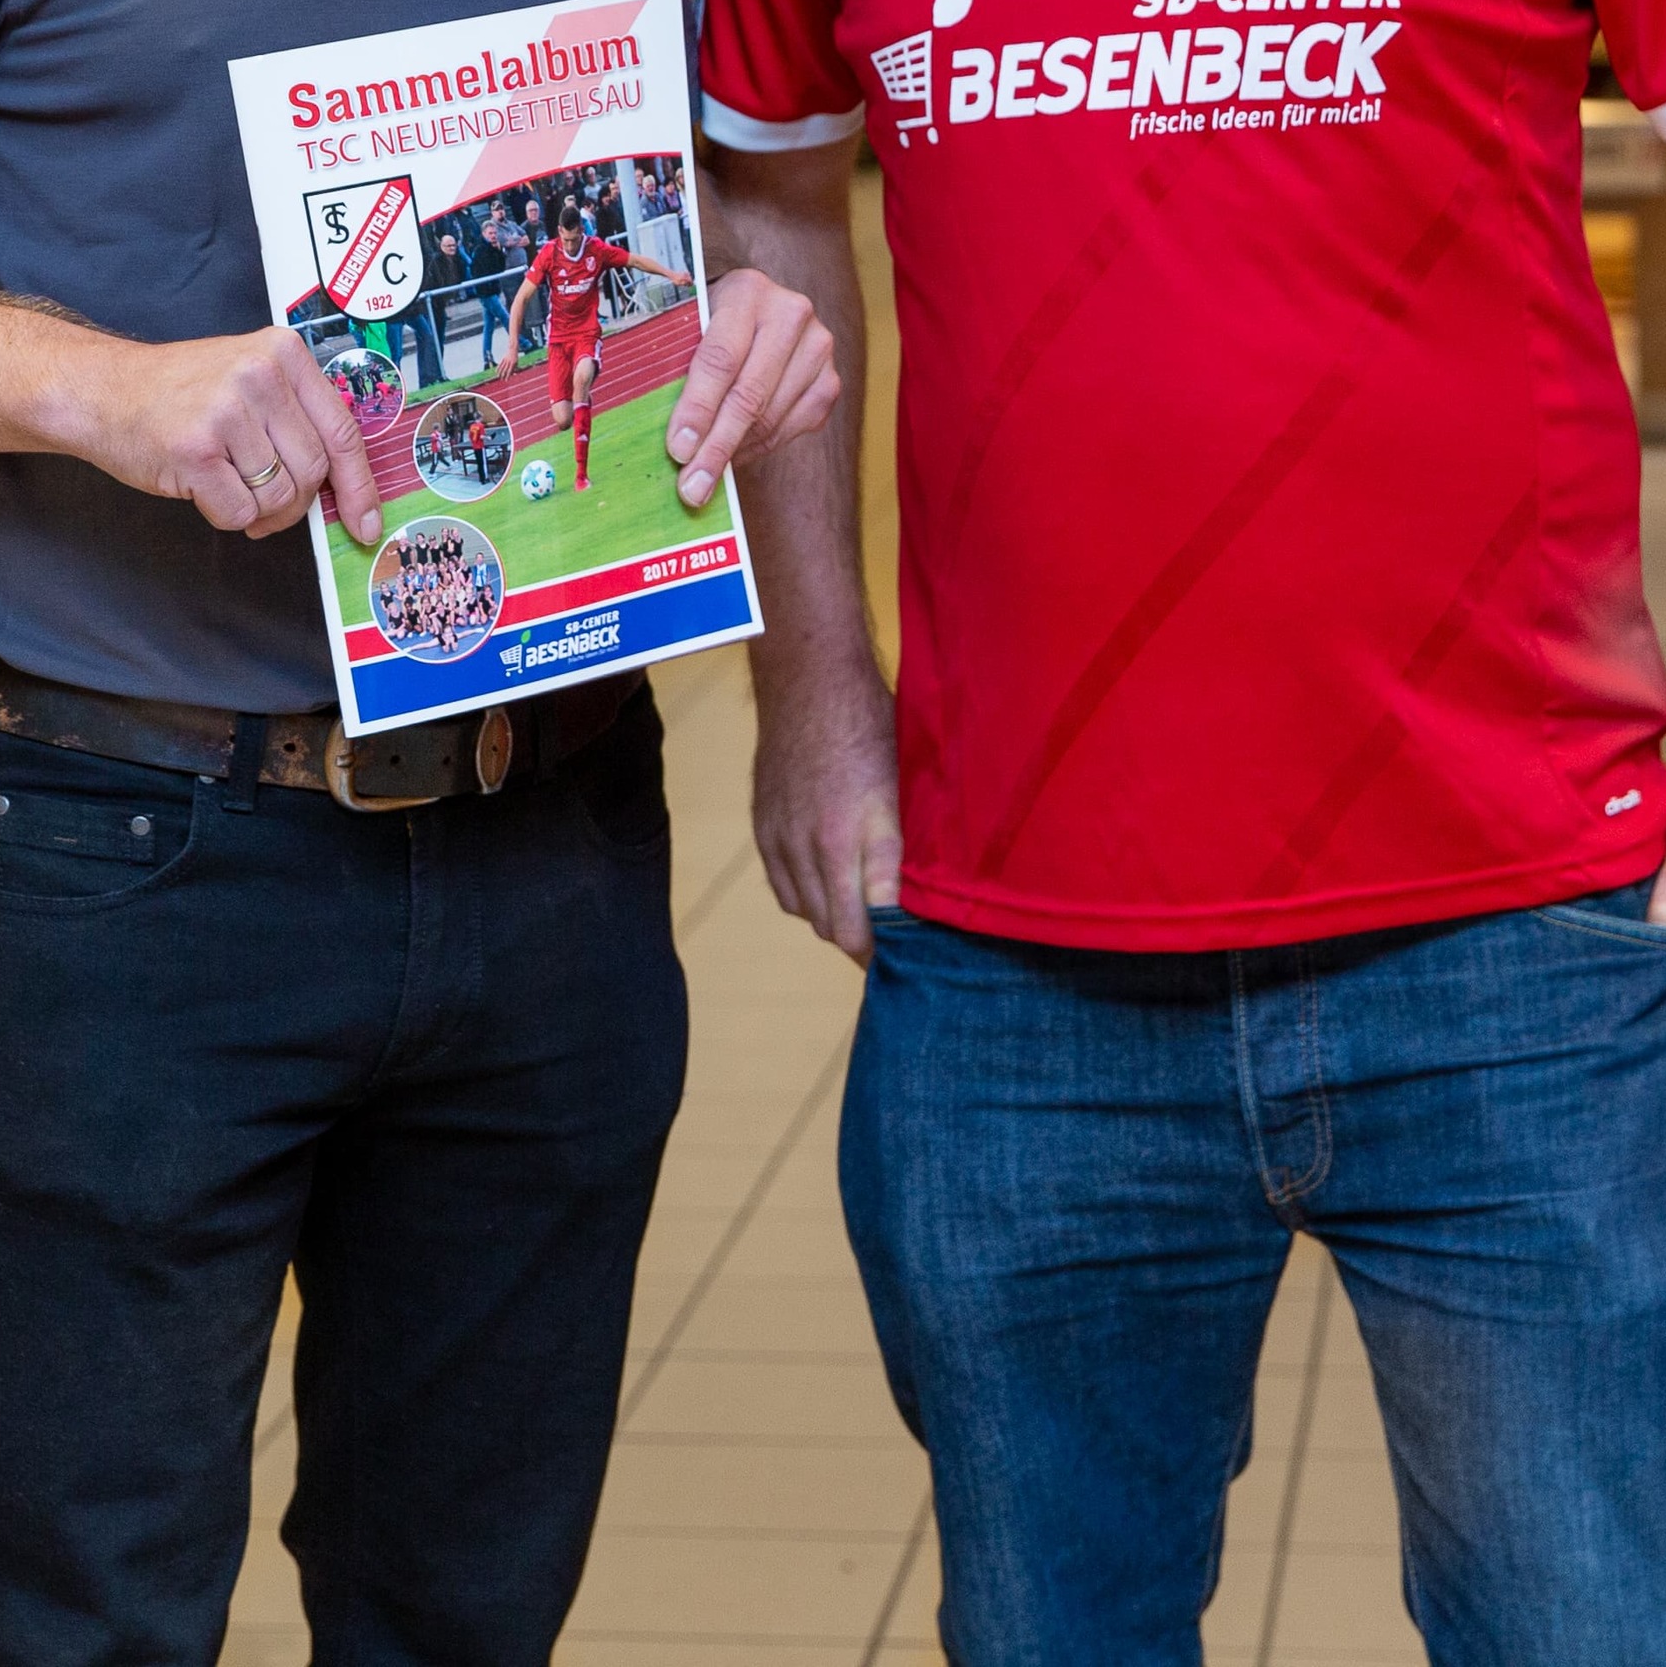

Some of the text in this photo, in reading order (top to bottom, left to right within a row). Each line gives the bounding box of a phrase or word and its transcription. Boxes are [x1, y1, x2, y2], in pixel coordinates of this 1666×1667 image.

[288, 33, 641, 131] Sammelalbum
[949, 20, 1403, 124] BESENBECK
[298, 79, 644, 172] TSC NEUENDETTELSAU
[1130, 99, 1381, 140] frische Ideen für mich!
[332, 185, 405, 298] NEUENDETTELSAU
[365, 294, 394, 313] 1922
[642, 558, 678, 583] 2017
[689, 545, 728, 570] 2018
[525, 623, 621, 668] BESENBECK
[564, 610, 620, 636] SB-CENTER
